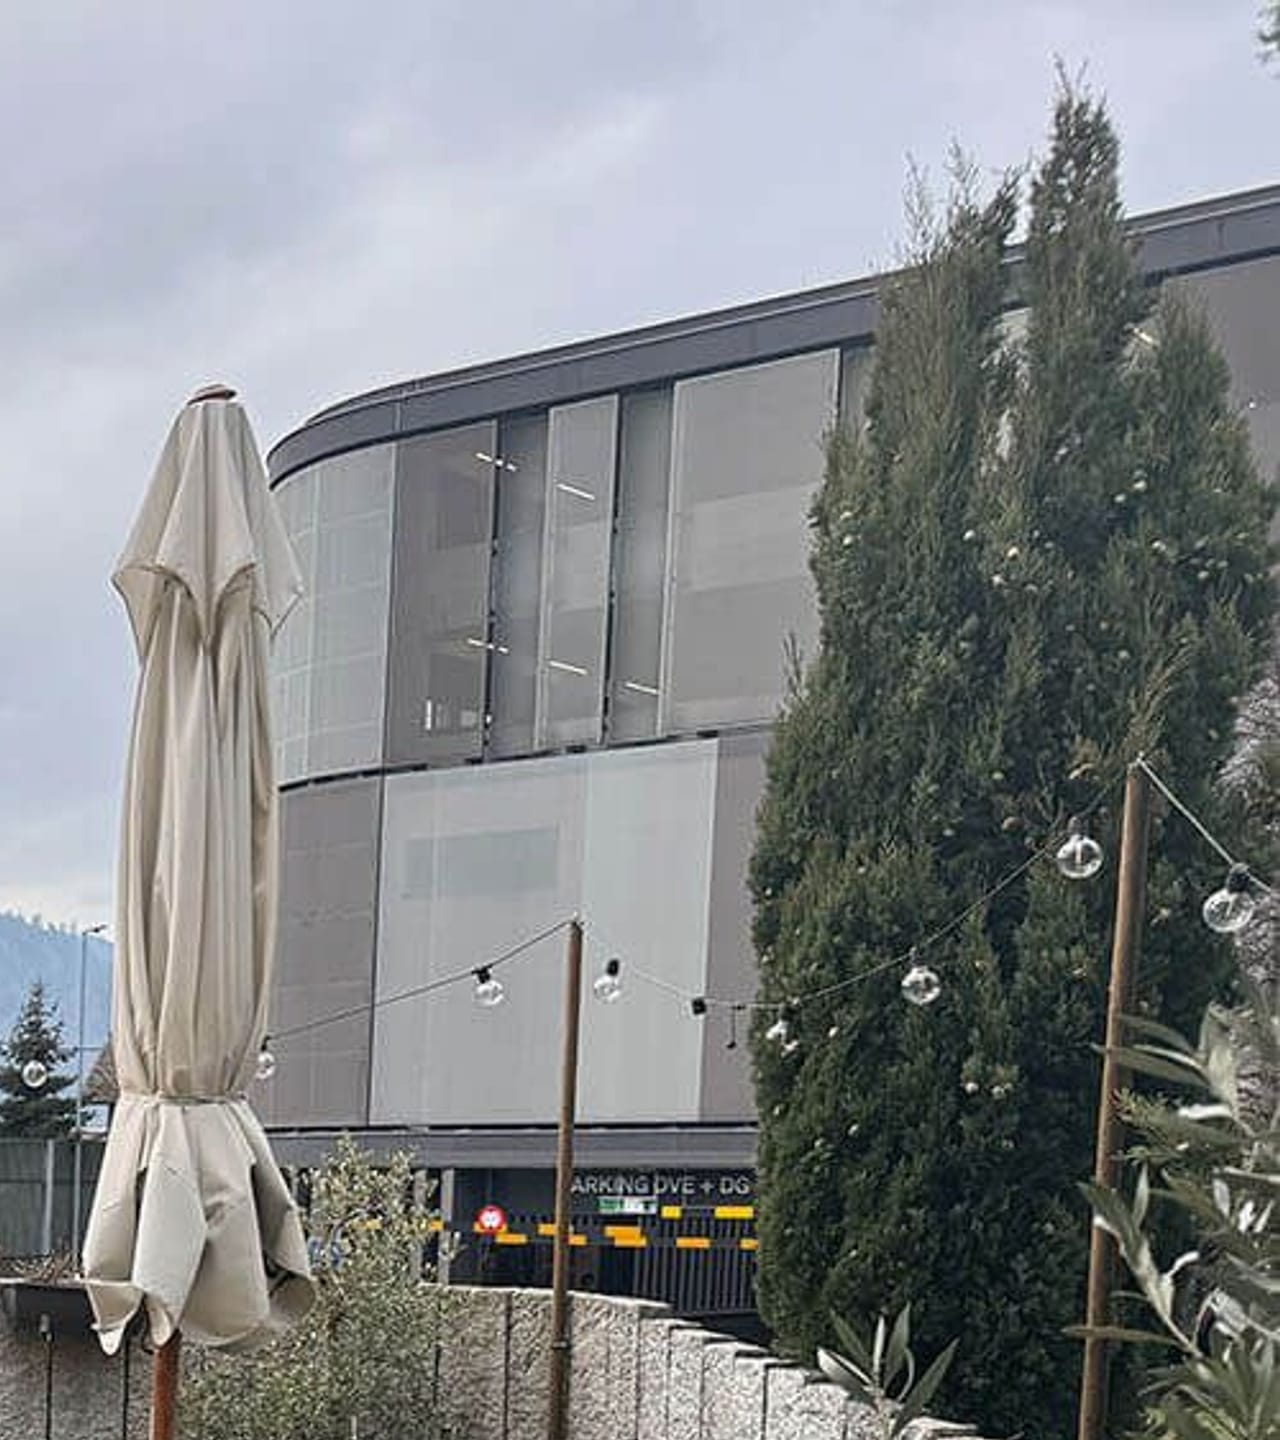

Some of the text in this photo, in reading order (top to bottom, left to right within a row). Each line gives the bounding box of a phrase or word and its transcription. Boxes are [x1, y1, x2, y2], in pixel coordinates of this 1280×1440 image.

[570, 1176, 750, 1195] ARKING DVE + DG
